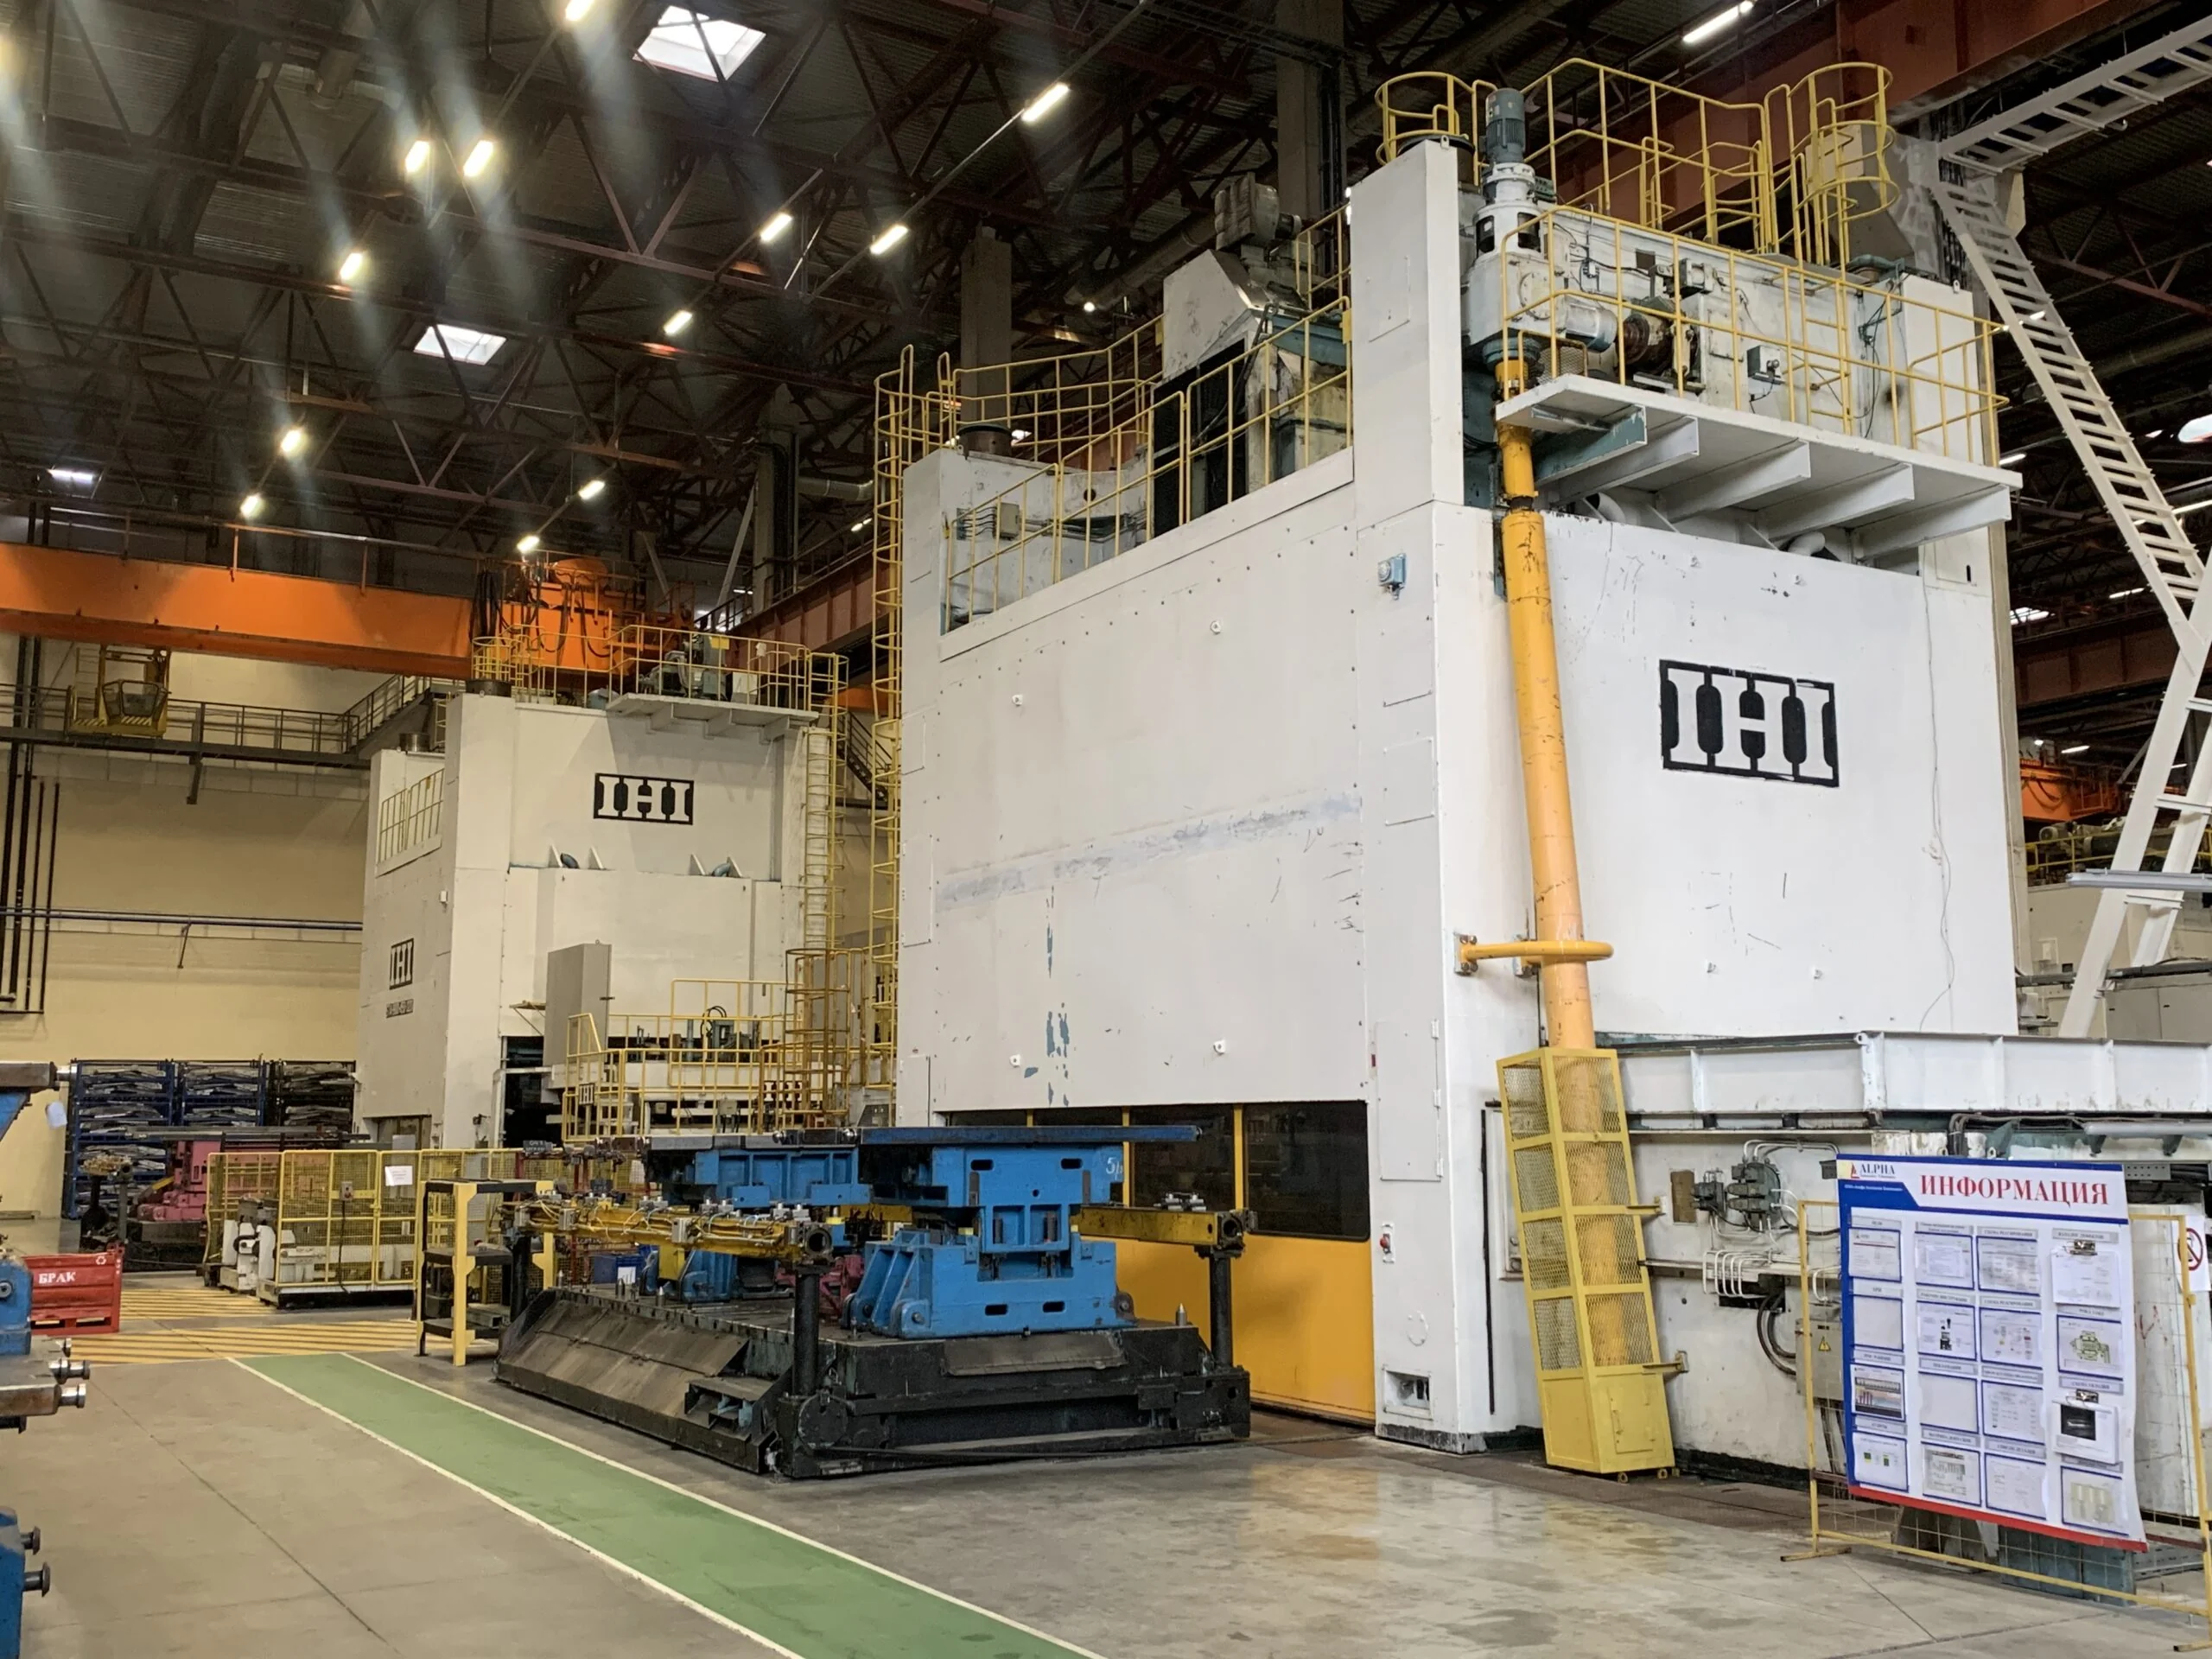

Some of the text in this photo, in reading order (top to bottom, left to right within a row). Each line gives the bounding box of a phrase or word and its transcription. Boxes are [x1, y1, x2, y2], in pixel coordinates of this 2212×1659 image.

[1660, 659, 1839, 787] IHI
[594, 773, 694, 825] IHI
[390, 938, 414, 990] IHI
[1859, 1163, 1895, 1175] ALPHA
[1921, 1175, 2108, 1207] ИНФОРМАЦИЯ
[39, 1272, 75, 1284] БРАК
